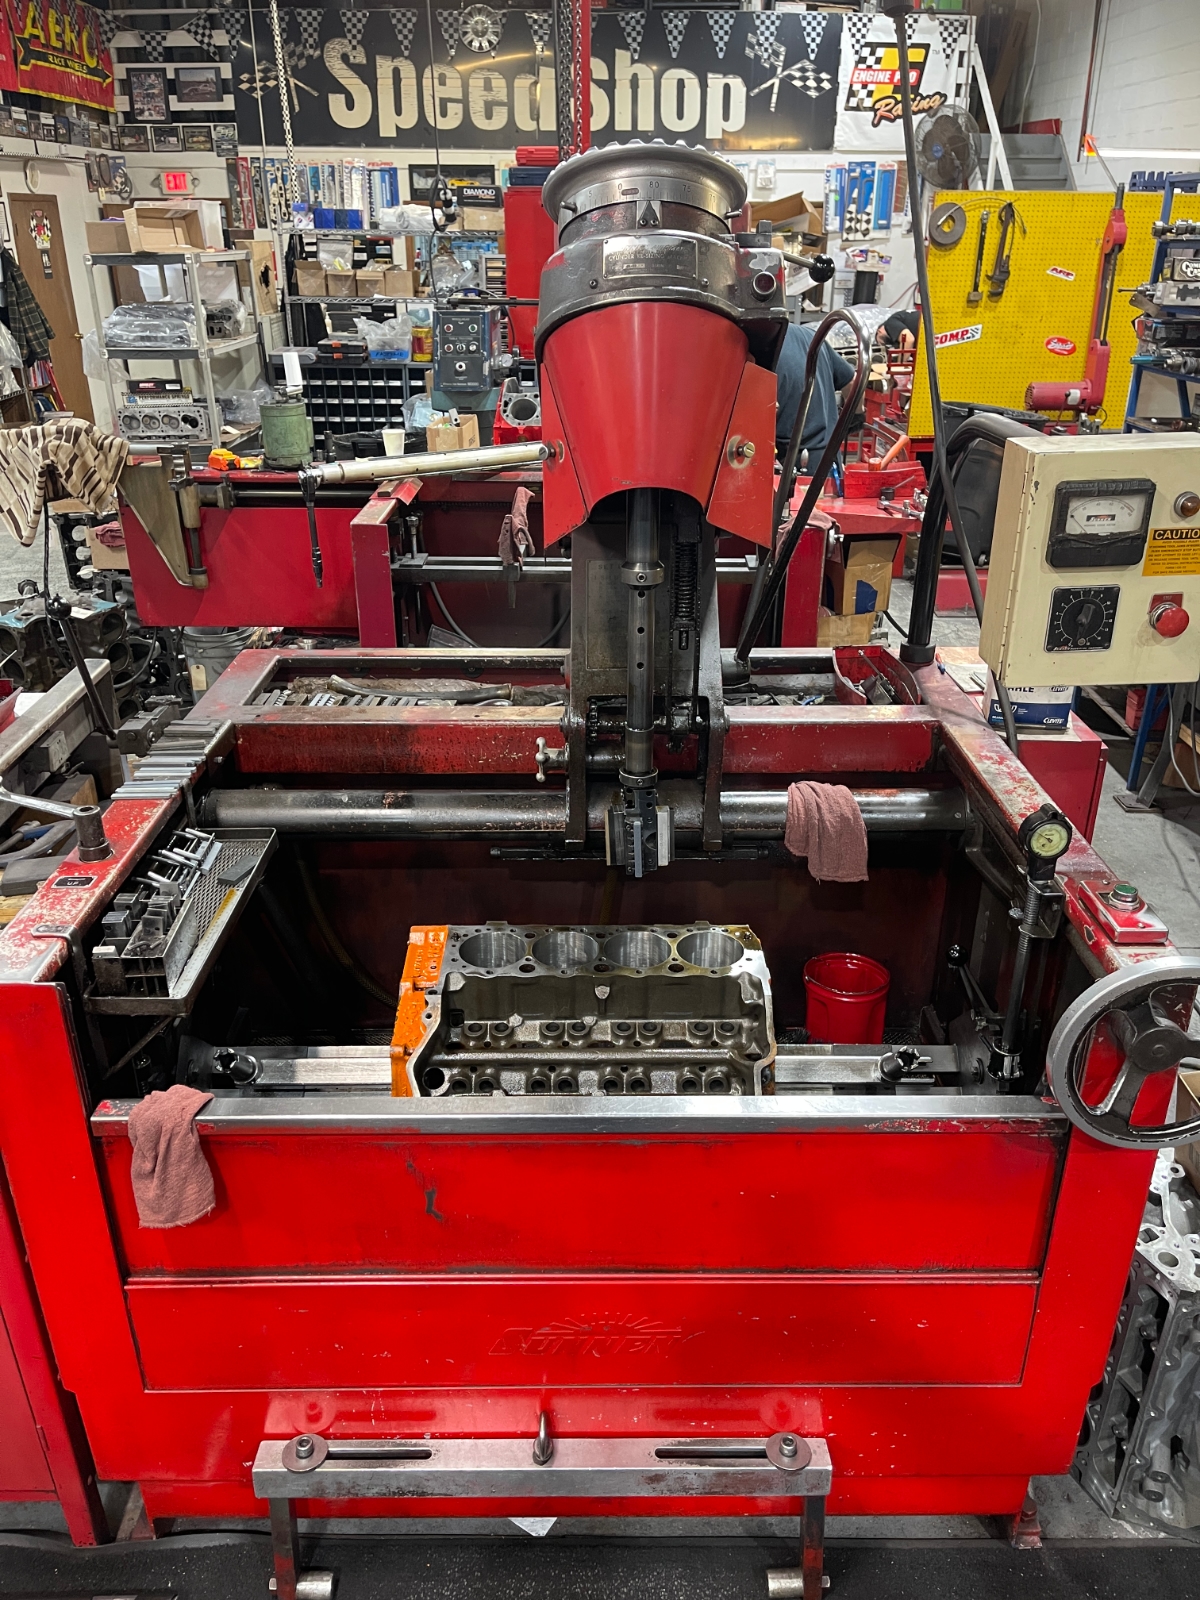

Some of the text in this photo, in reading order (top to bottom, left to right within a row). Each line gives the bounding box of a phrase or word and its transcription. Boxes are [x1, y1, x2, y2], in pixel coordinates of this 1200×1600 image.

[48, 54, 65, 66] RACE
[853, 70, 918, 83] ENGINE PO
[323, 37, 747, 140] Speed Shop
[873, 94, 946, 125] Raing
[165, 172, 188, 192] EXIT
[463, 188, 496, 196] DIAMOND
[682, 184, 691, 193] 75
[1050, 267, 1074, 278] ARP
[1155, 529, 1200, 540] CAUTIO
